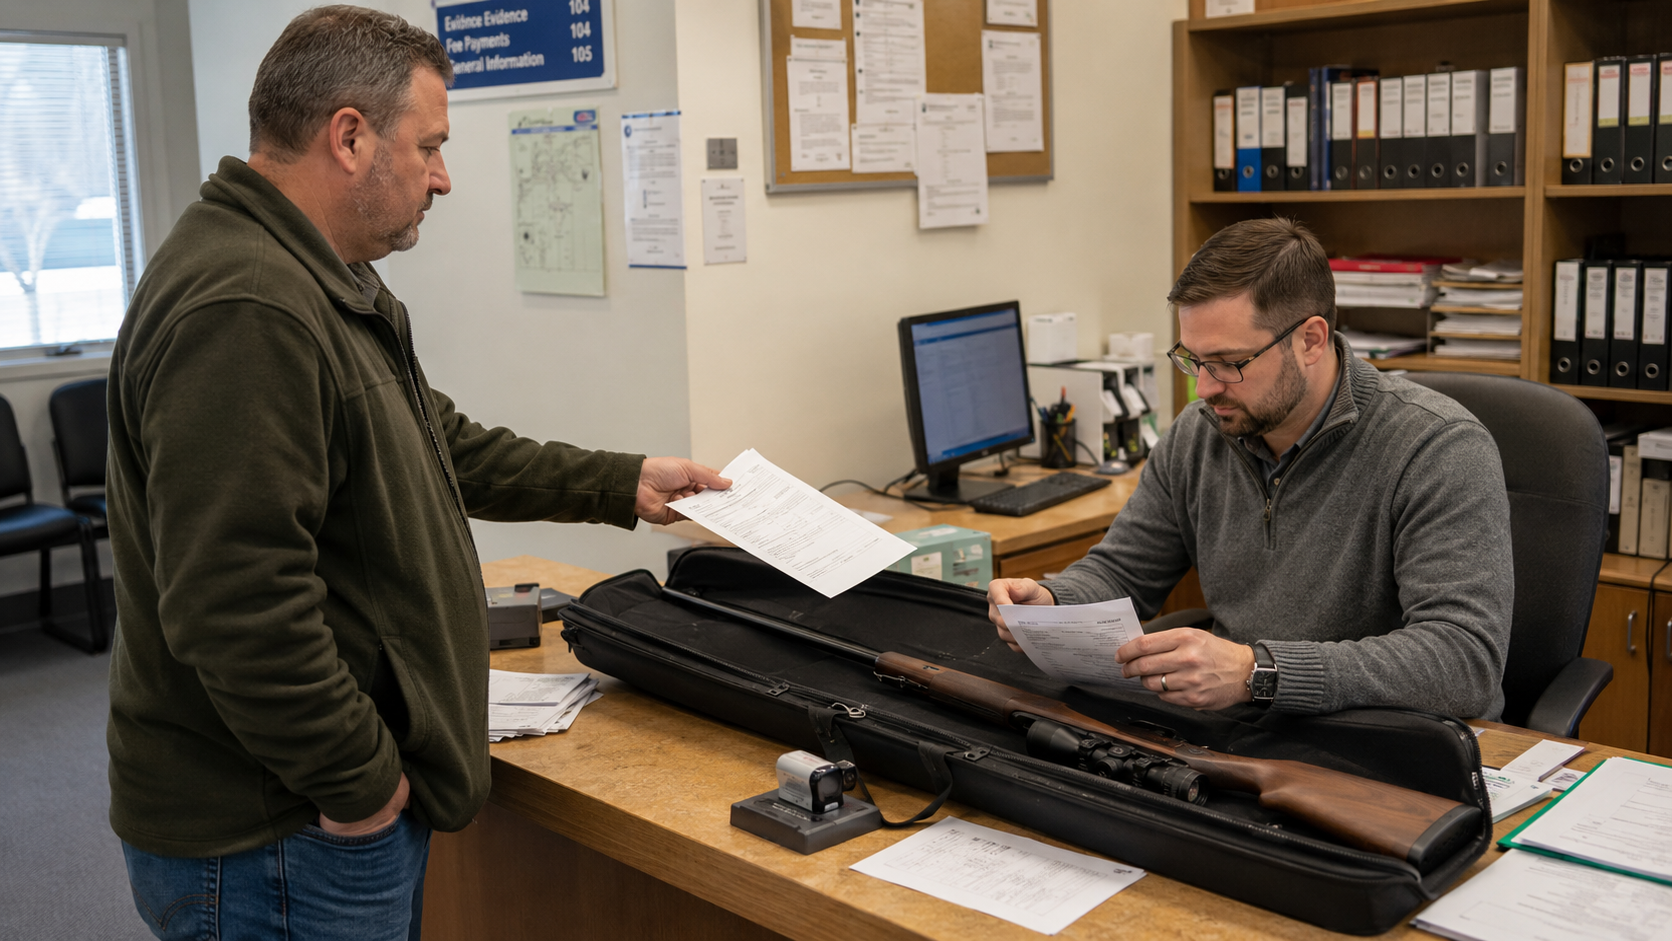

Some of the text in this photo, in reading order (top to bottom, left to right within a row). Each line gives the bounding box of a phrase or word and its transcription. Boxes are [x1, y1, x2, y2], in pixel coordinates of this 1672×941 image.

[484, 9, 528, 27] Evidence
[569, 0, 590, 15] 104
[446, 21, 591, 54] Fee Payments 104
[486, 52, 544, 71] Information
[571, 45, 593, 63] 105
